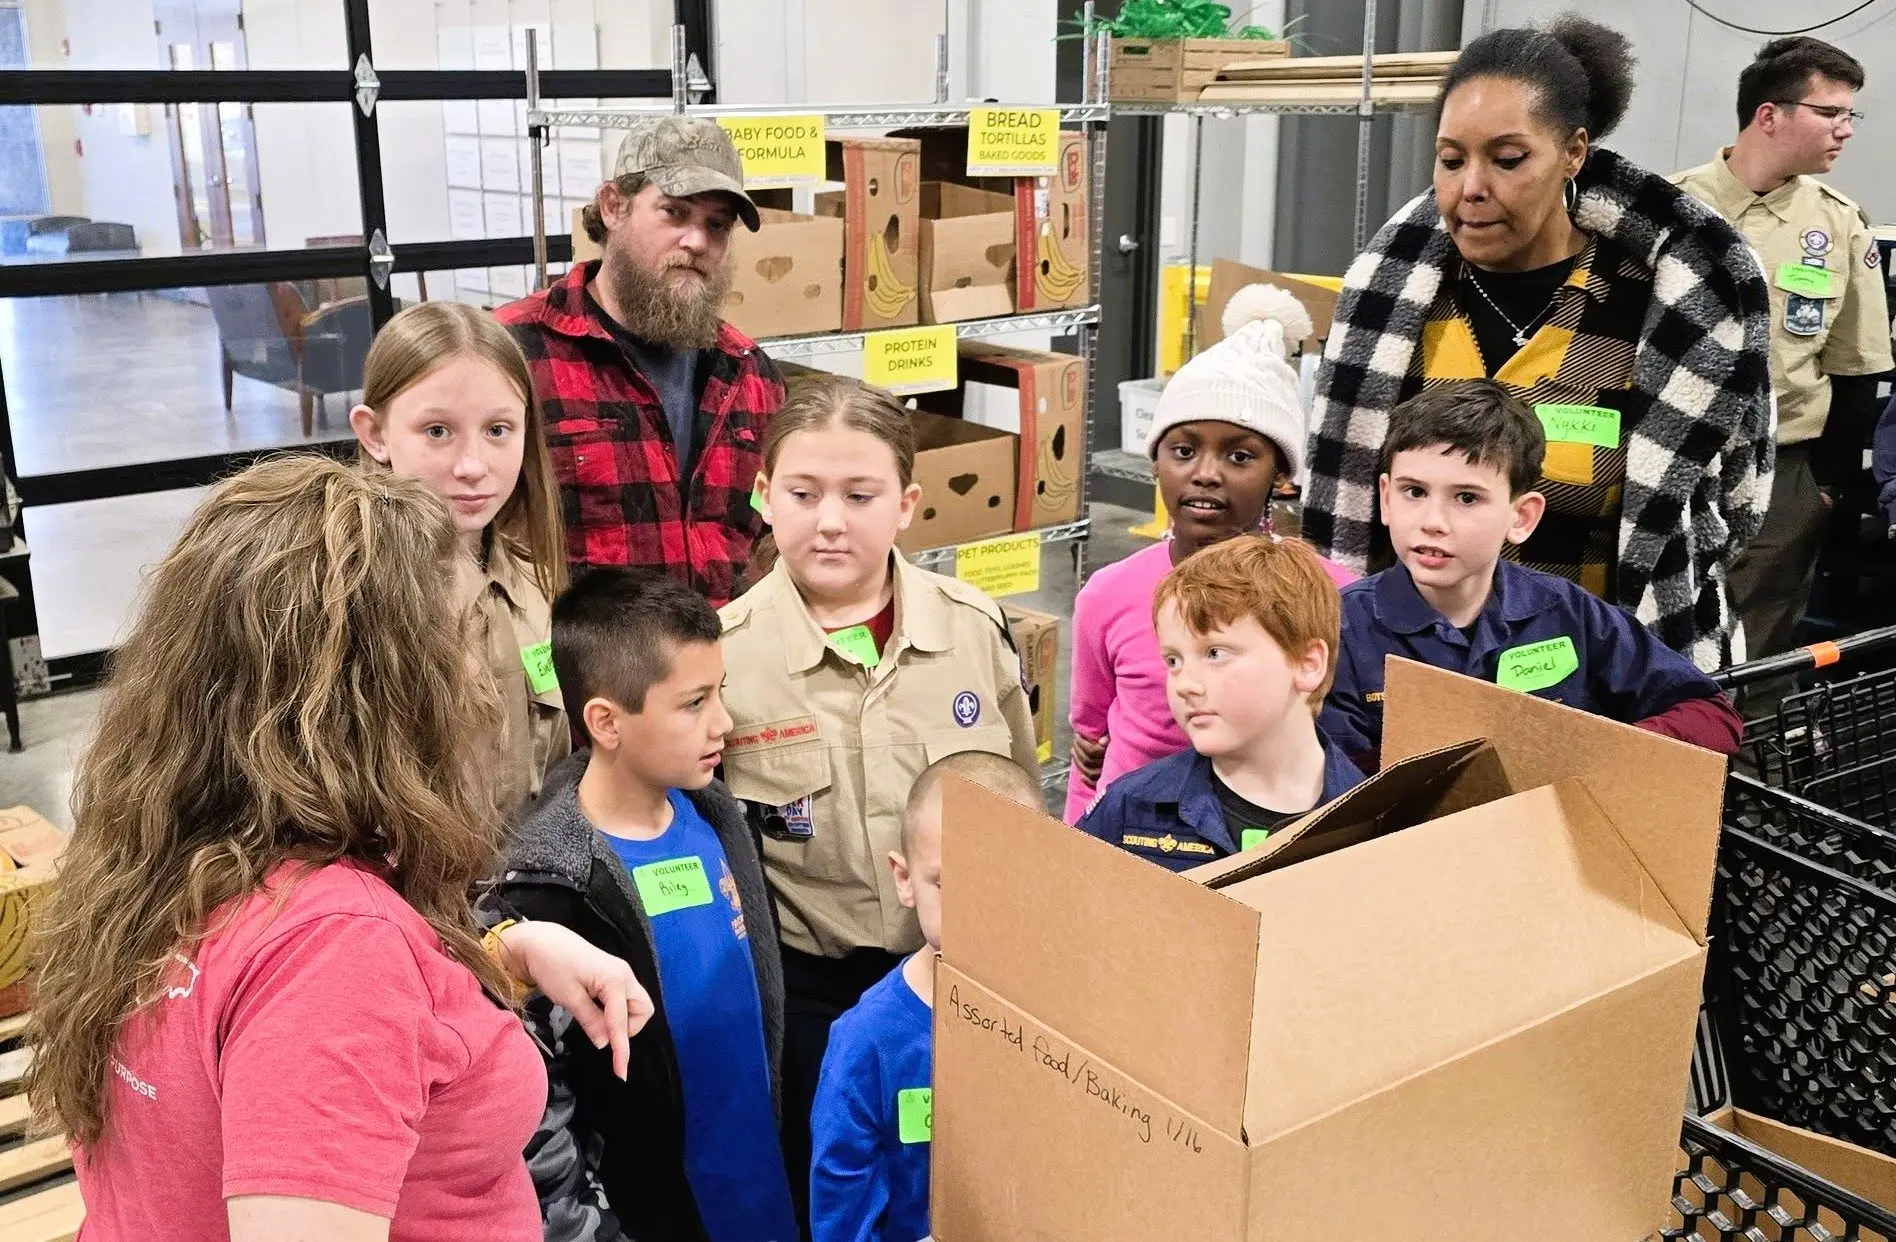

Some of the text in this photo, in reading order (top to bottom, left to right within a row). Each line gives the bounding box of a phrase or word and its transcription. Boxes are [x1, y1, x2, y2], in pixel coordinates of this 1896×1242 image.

[987, 112, 1042, 128] BREAD
[766, 126, 805, 140] FOOD
[809, 126, 818, 138] &
[980, 132, 1046, 145] TORTILLAS
[738, 147, 806, 160] FORMULA
[978, 150, 1046, 161] BAKED GOODS
[884, 338, 937, 354] PROTEIN
[888, 356, 933, 372] DRINKS
[1556, 408, 1615, 419] VOLUNTEER
[957, 538, 1040, 559] PET PRODUCTS
[1508, 641, 1566, 660] VOLUNTEER
[1510, 655, 1556, 677] Daniel
[780, 725, 816, 739] AMERICA
[786, 807, 803, 816] DAY
[1122, 834, 1215, 855] SCOUTING AMERICA
[652, 862, 699, 876] VOLUNTEER
[658, 881, 689, 896] Riley
[950, 984, 1023, 1052] Assorted
